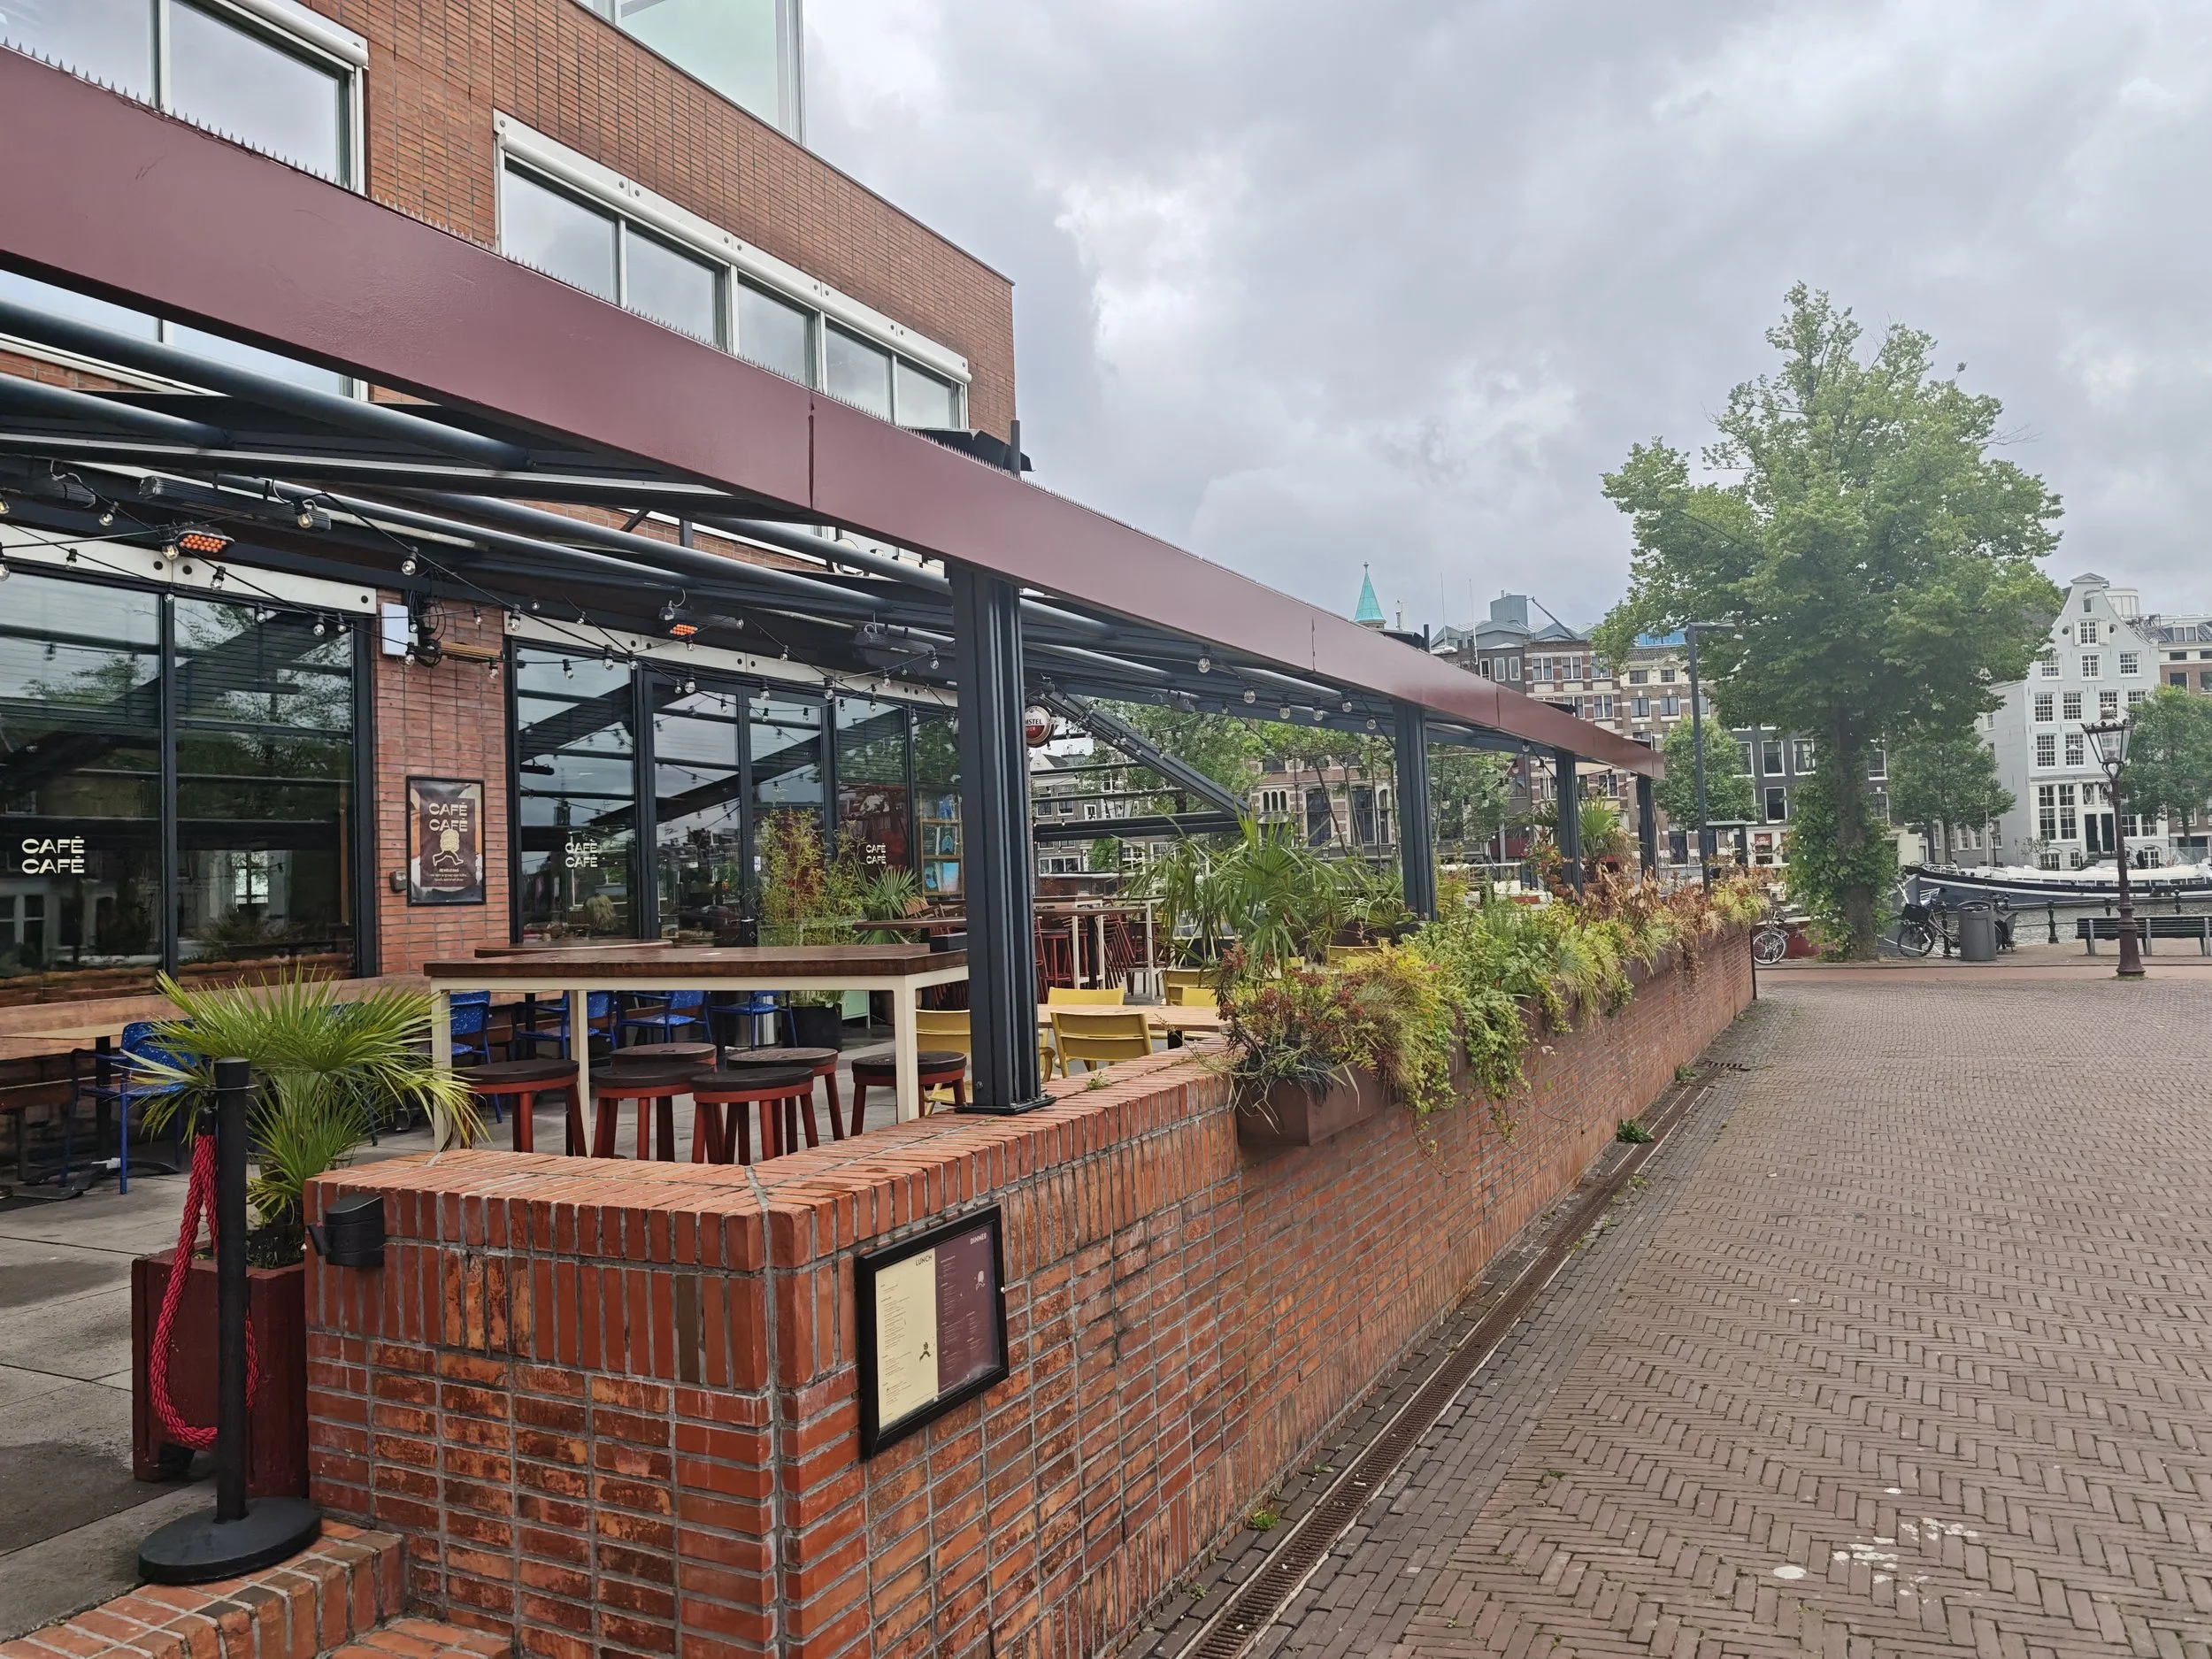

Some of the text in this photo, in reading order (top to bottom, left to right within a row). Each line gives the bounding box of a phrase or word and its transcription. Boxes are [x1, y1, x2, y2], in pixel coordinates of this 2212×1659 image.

[429, 803, 467, 816] CAFÉ
[429, 818, 467, 832] CAFÉ
[22, 836, 85, 854] CAFÉ
[866, 842, 886, 853] CAFÉ
[22, 856, 85, 874] CAFÉ
[565, 855, 597, 867] CAFÉ
[866, 854, 886, 864] CAFÉ
[970, 1233, 987, 1245] DINNER
[915, 1255, 933, 1266] LUNCH
